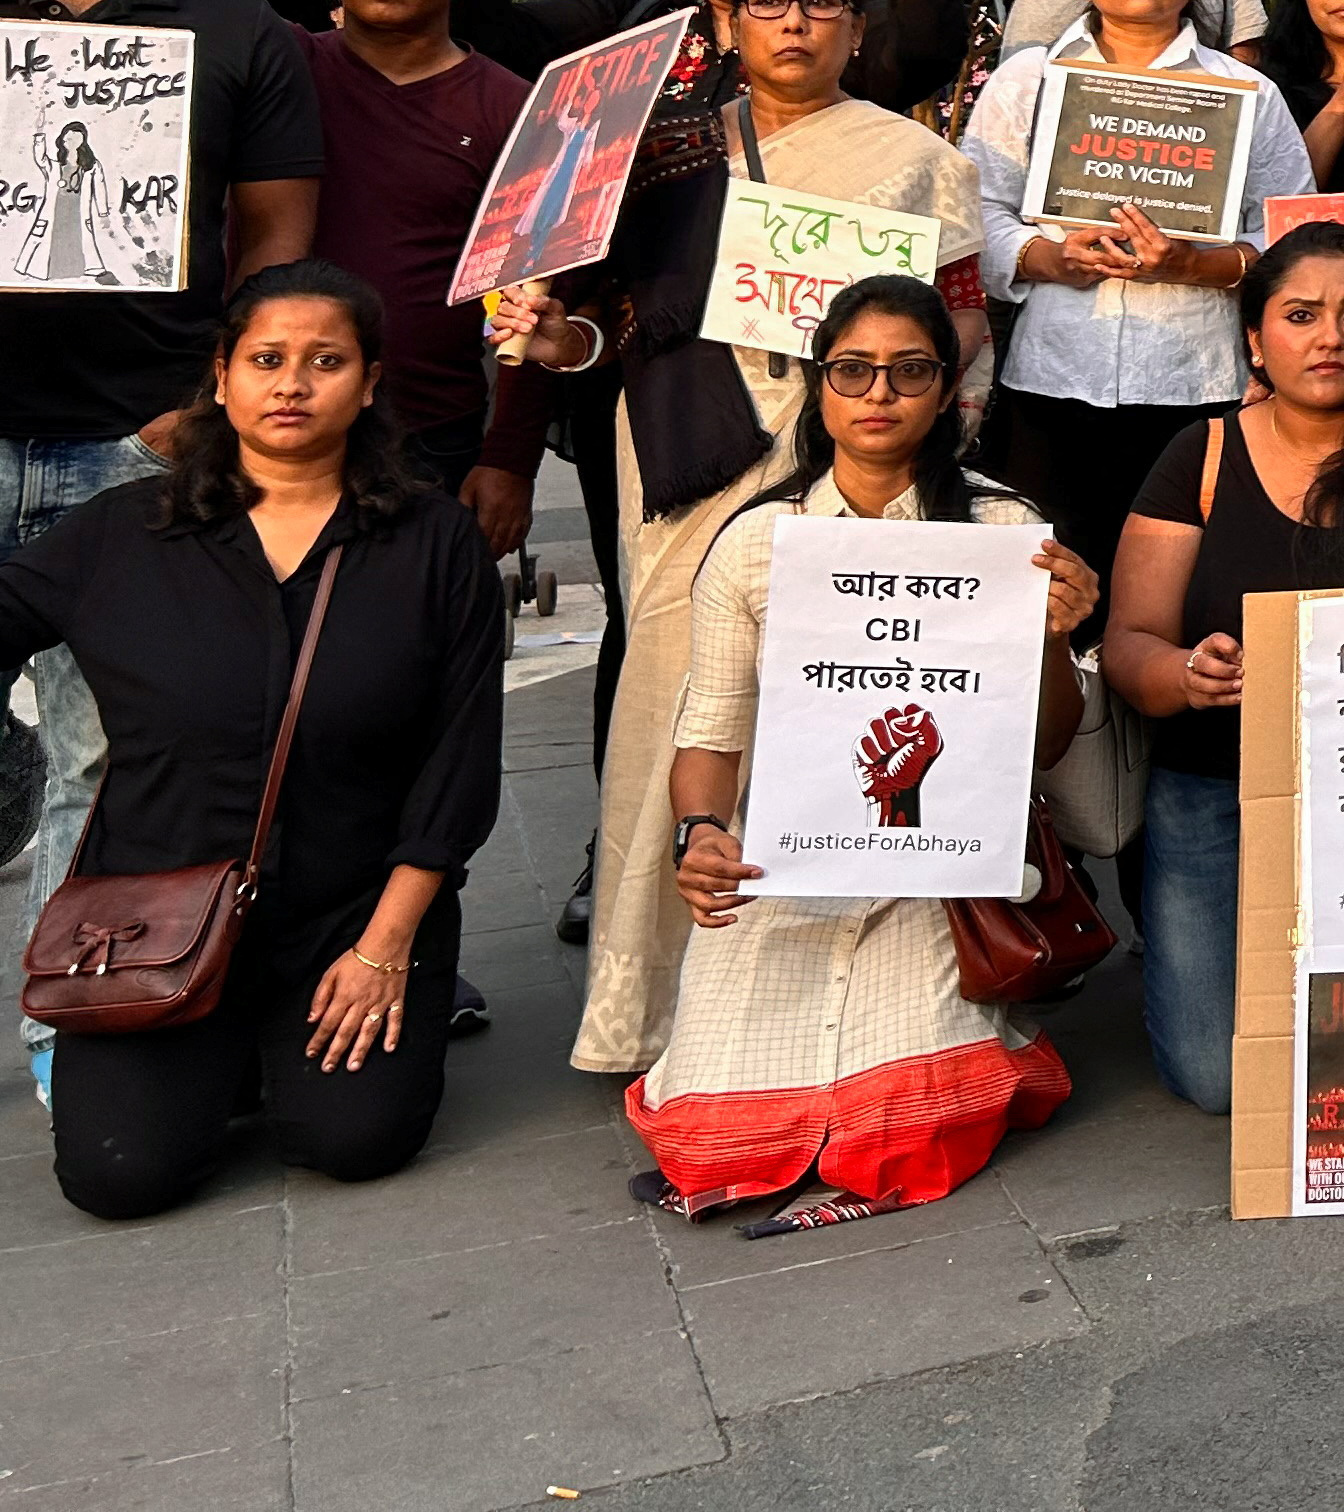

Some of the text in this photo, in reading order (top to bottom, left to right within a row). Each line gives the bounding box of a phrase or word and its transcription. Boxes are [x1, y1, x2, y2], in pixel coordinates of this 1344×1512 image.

[57, 72, 186, 108] JUSTICE
[1089, 113, 1206, 143] WE DEMAND
[1070, 133, 1217, 171] JUSTICE
[1084, 160, 1195, 188] FOR VICTIM
[121, 174, 178, 216] KAR
[1056, 187, 1175, 210] Justice delayed justice
[737, 196, 844, 265] দূরে
[831, 571, 981, 601] আর কবে?
[865, 617, 921, 642] CBI
[802, 657, 981, 694] পারতেই হবে।
[778, 833, 982, 857] #justiceForAbhaya
[1308, 1157, 1323, 1171] WE
[1309, 1172, 1333, 1185] WITH
